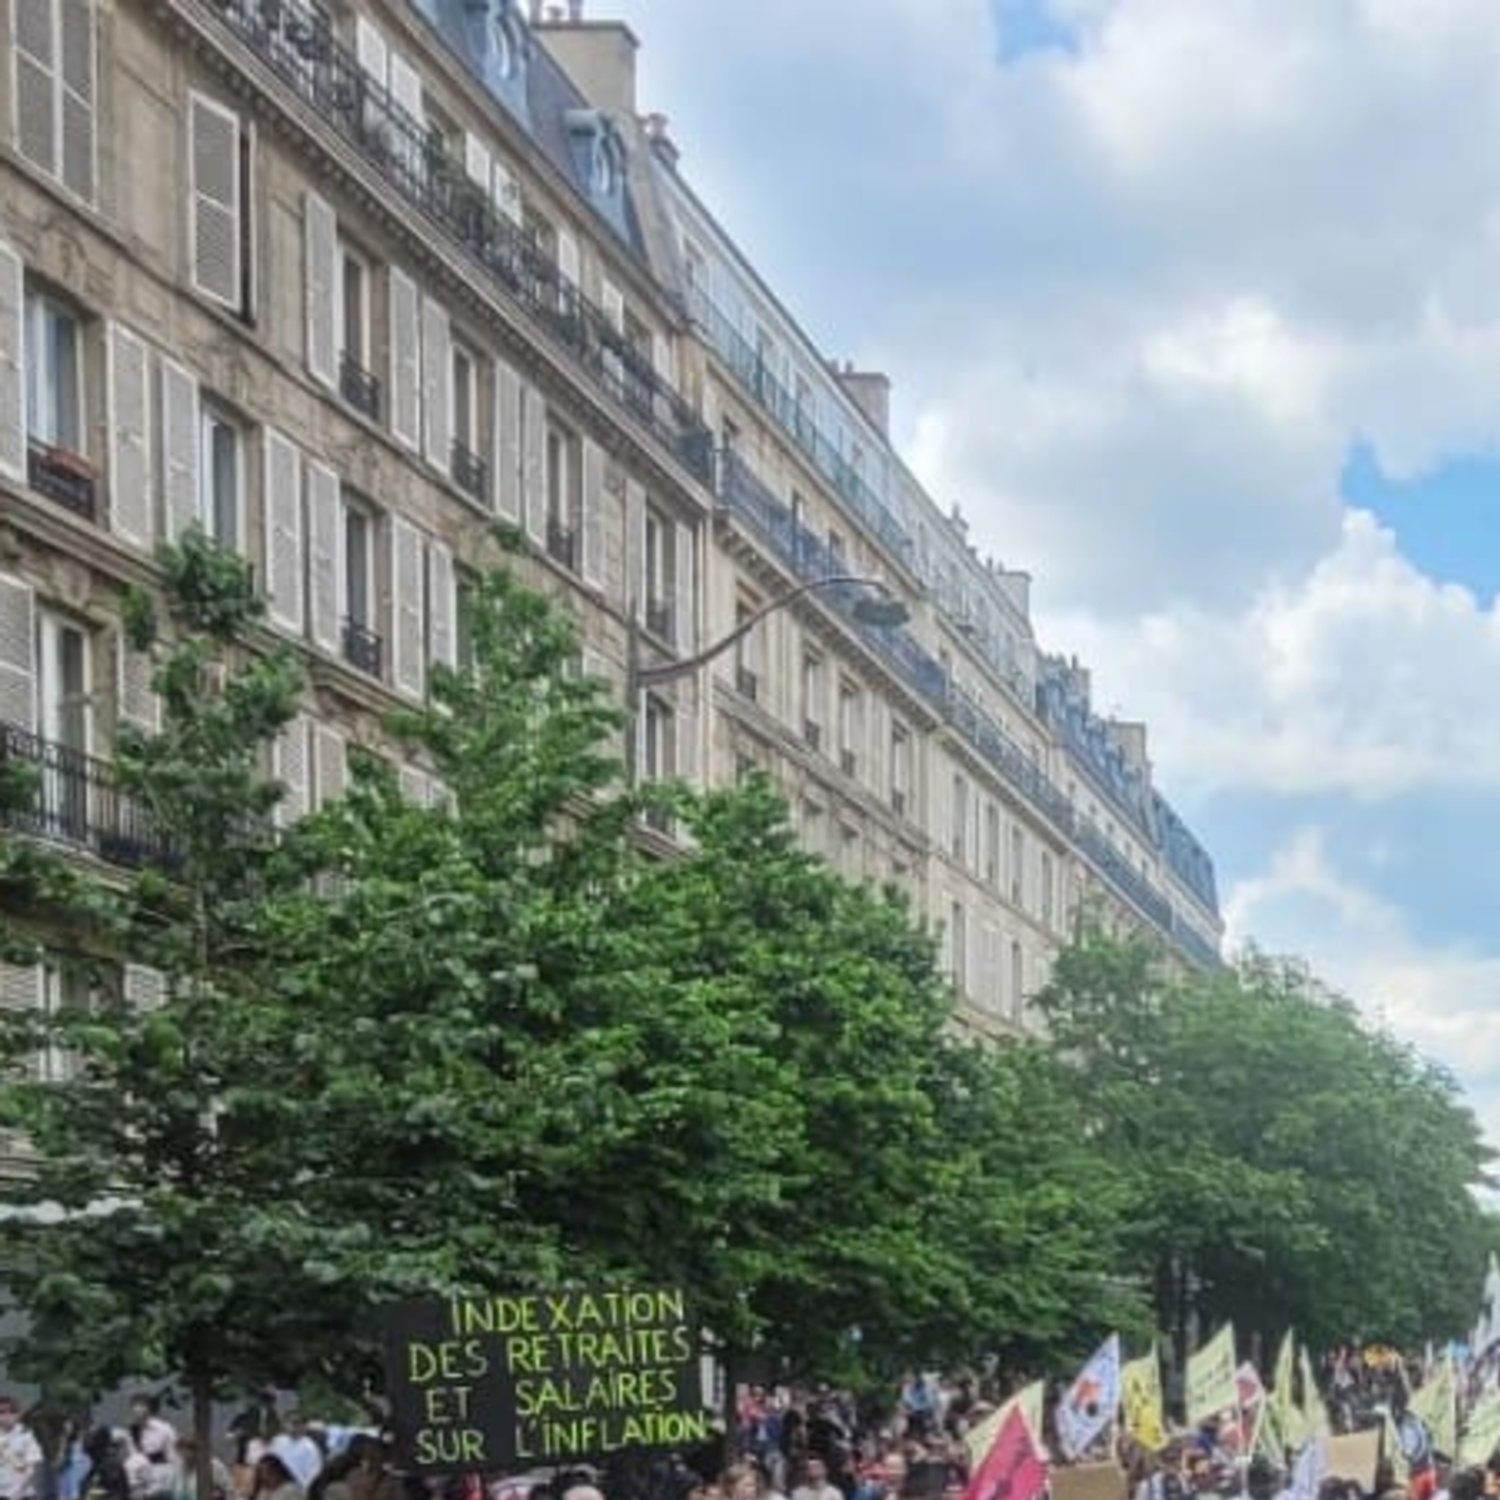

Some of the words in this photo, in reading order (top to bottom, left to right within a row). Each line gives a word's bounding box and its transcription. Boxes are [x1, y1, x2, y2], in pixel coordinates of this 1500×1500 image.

[409, 1339, 488, 1382] DES
[506, 1325, 691, 1373] RETRAITES
[425, 1385, 472, 1424] ET
[515, 1368, 676, 1416] SALAIRES
[416, 1428, 485, 1465] SUR
